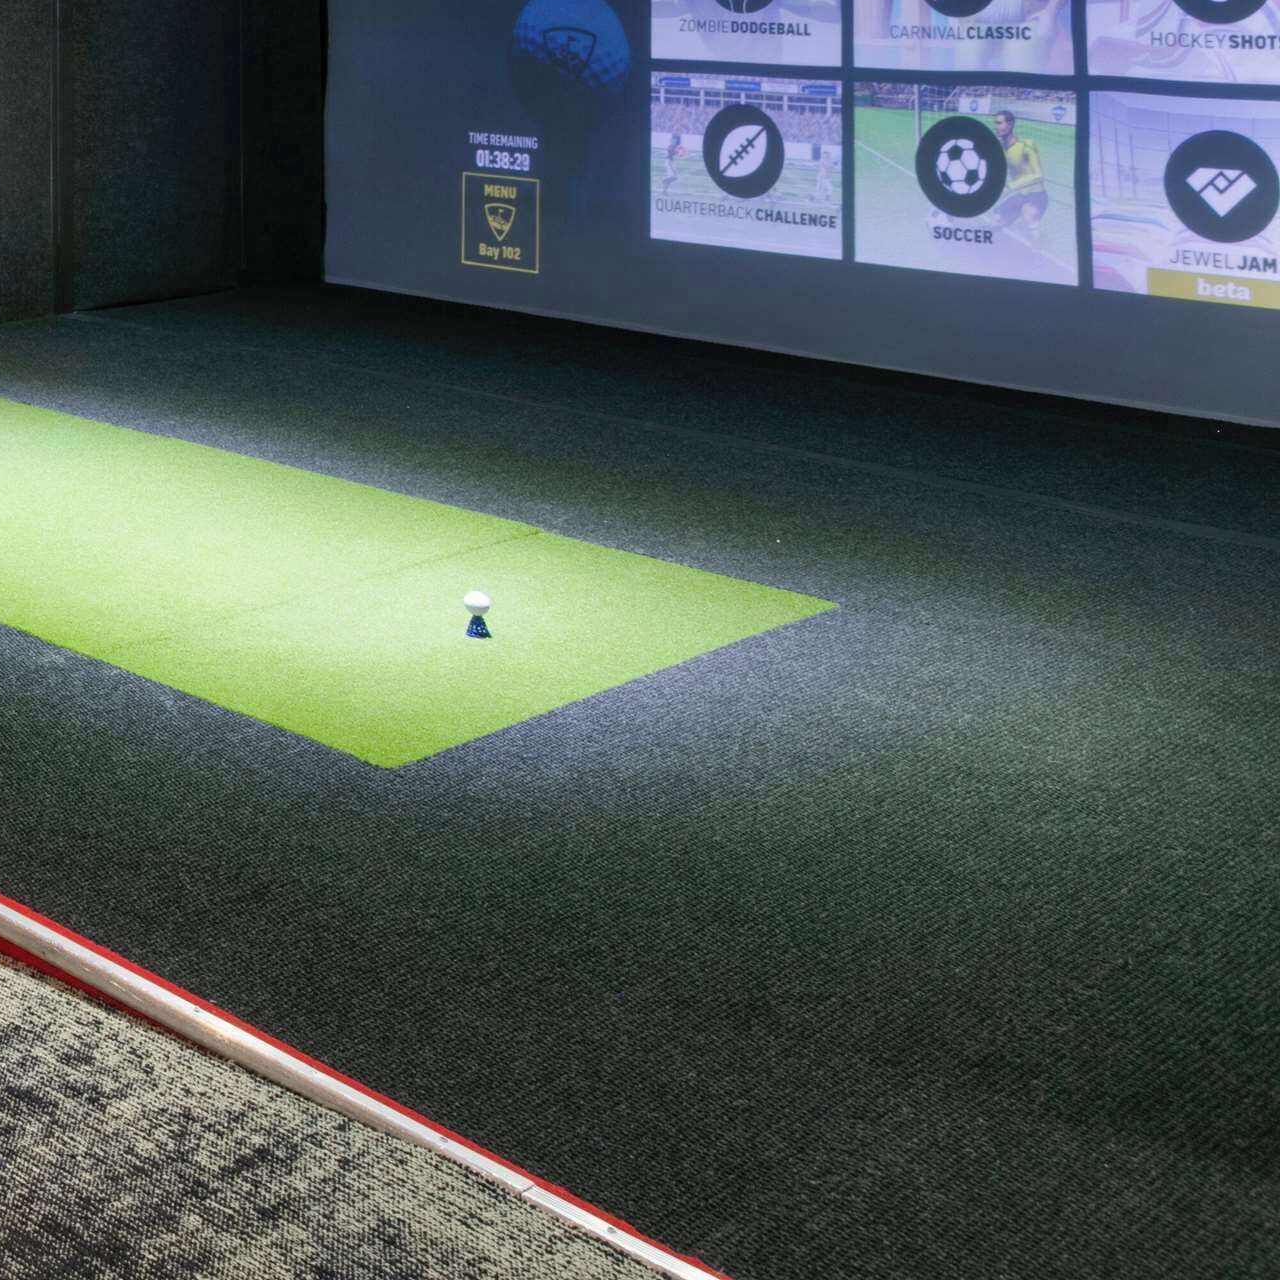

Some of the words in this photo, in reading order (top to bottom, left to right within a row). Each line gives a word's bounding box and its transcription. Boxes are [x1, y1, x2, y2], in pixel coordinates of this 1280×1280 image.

[468, 131, 489, 145] TIME
[490, 133, 539, 150] REMAINING
[483, 183, 518, 199] MENU
[932, 225, 993, 244] SOCCER
[479, 243, 500, 260] Bay
[502, 246, 521, 261] 102
[1196, 277, 1251, 301] beta
